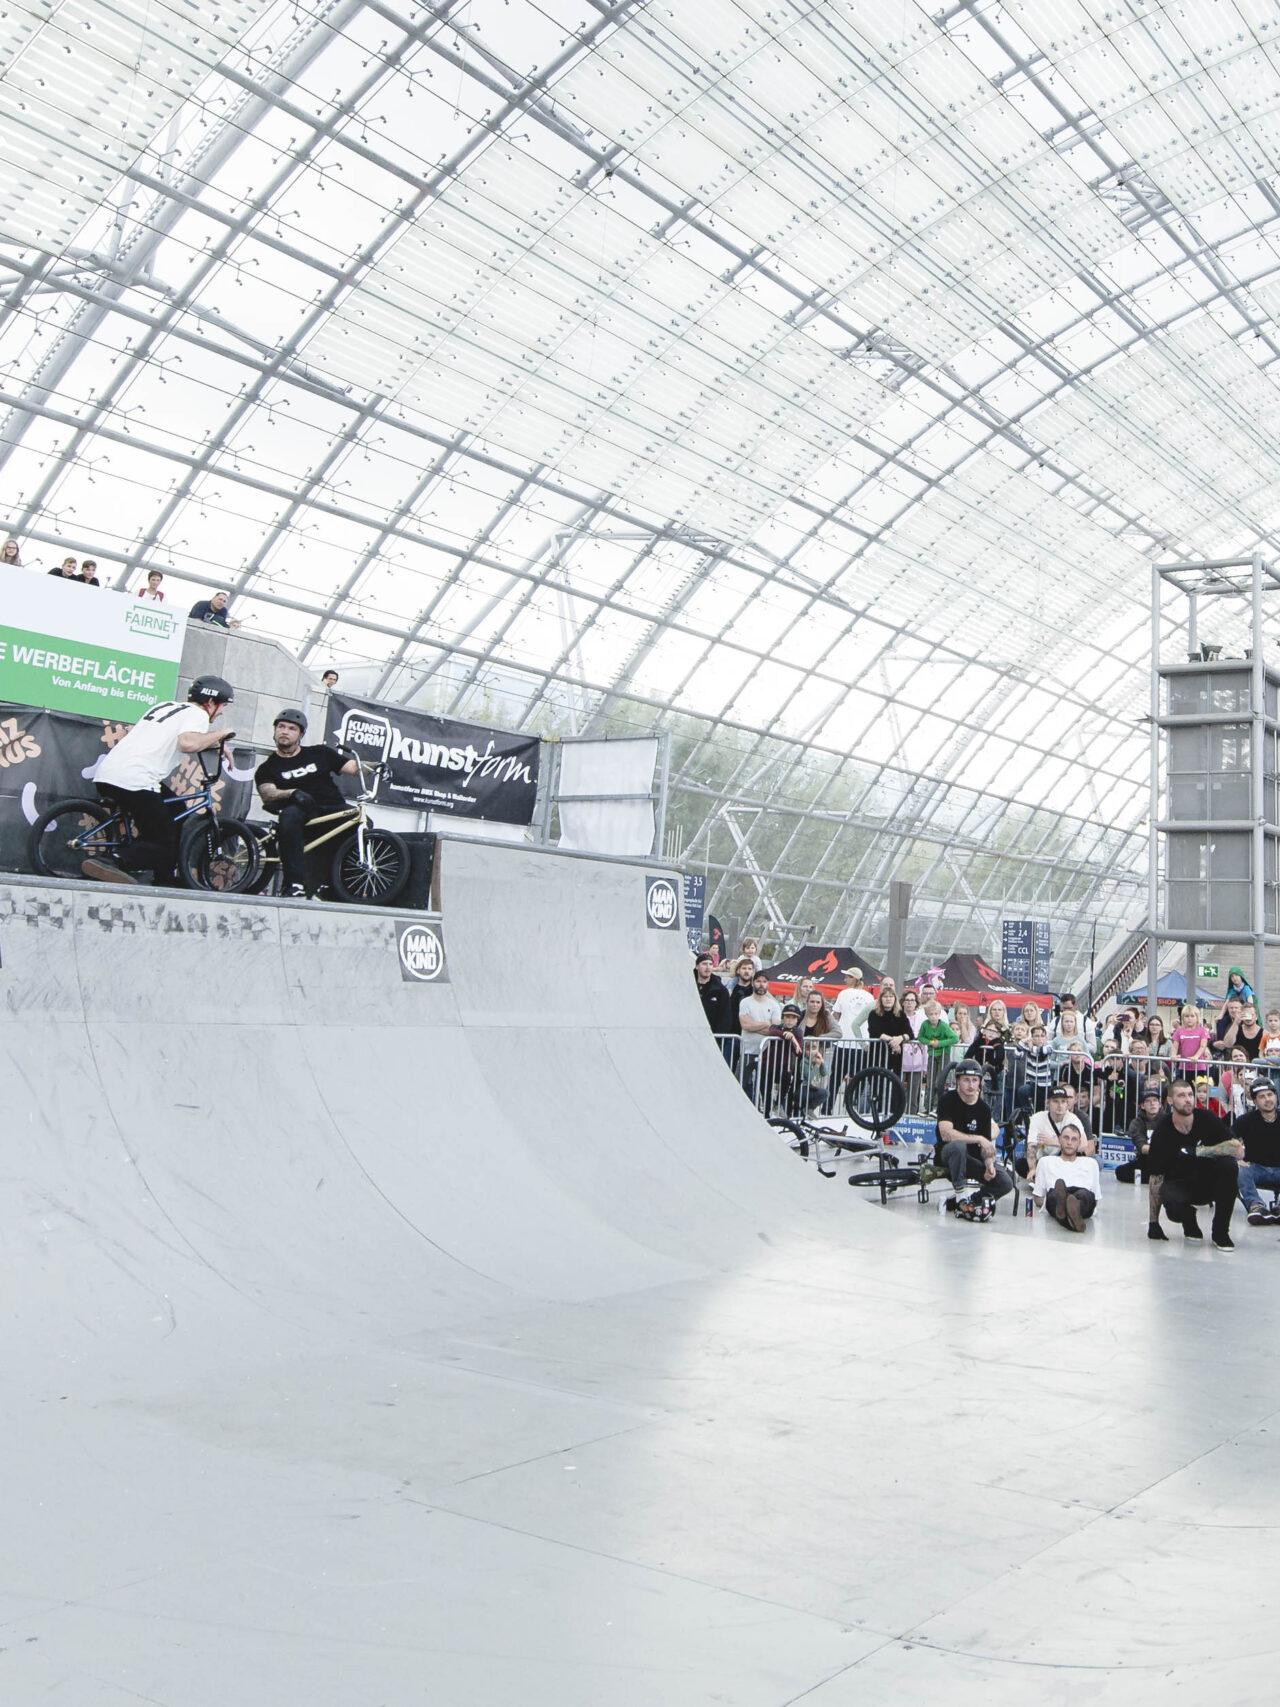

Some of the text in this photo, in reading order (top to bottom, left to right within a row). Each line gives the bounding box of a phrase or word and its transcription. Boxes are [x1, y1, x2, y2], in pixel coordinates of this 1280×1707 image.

[125, 611, 179, 634] FAIRNET
[12, 644, 156, 690] WERBEFLÄCHE
[52, 675, 158, 705] Von Anfang bis Erfolg!
[347, 719, 386, 737] KUNST
[346, 729, 386, 748] FORM
[652, 888, 674, 905] MAN
[651, 902, 674, 919] KIND
[407, 934, 437, 953] MAN
[407, 951, 437, 970] KIND
